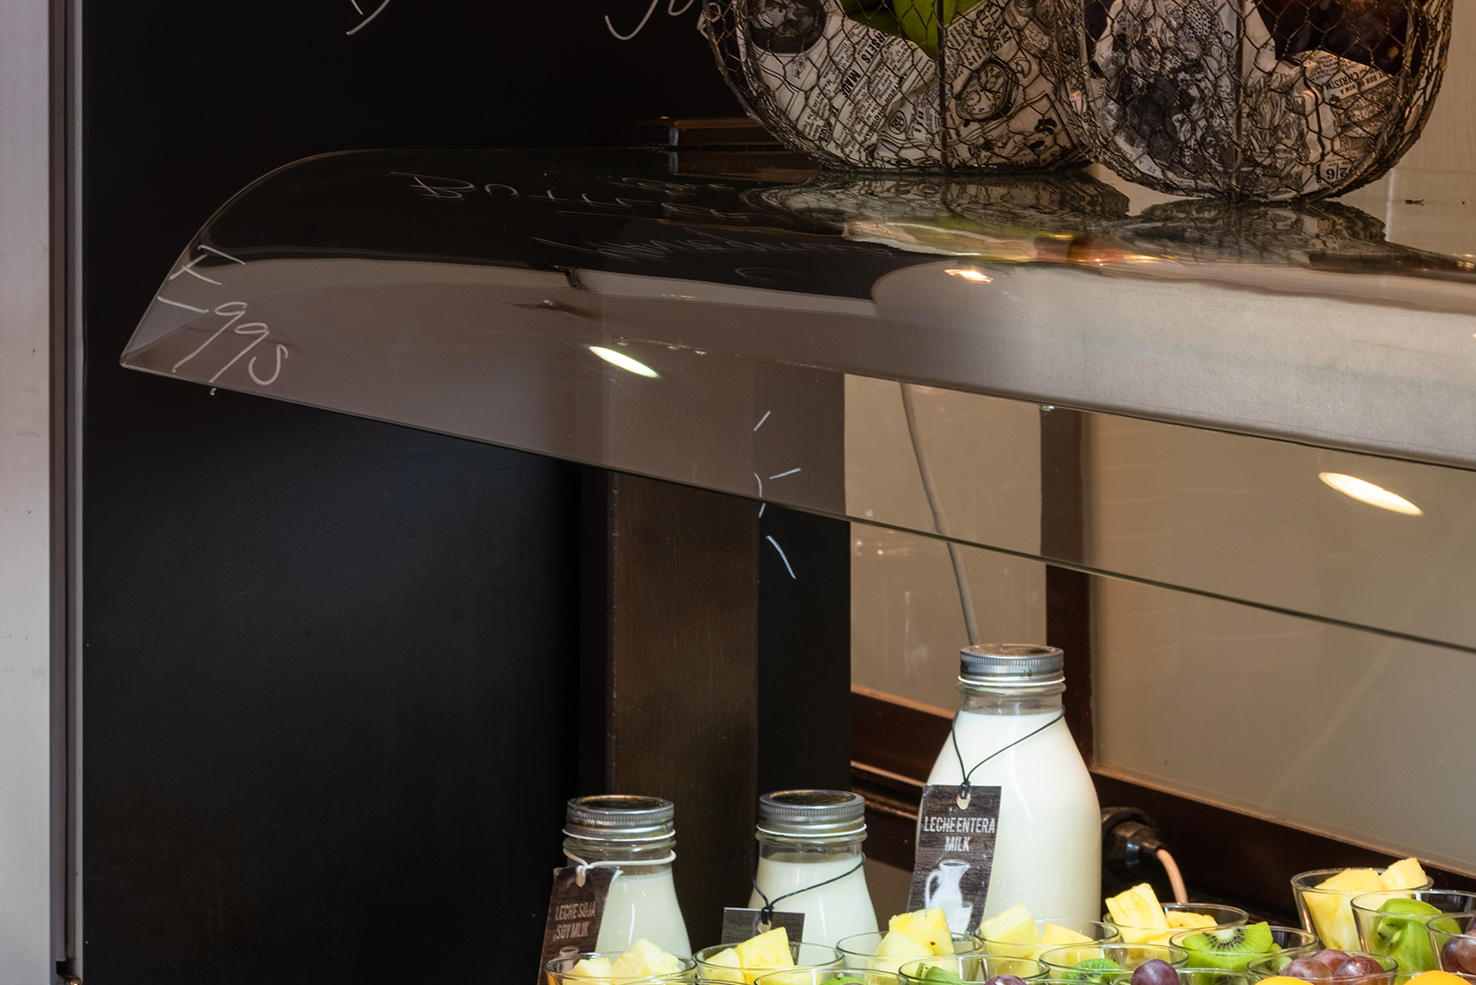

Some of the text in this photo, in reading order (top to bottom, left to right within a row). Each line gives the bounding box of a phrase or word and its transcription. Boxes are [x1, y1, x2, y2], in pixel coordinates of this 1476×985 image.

[924, 816, 996, 834] LECHE ENTERA
[944, 836, 970, 852] MILK
